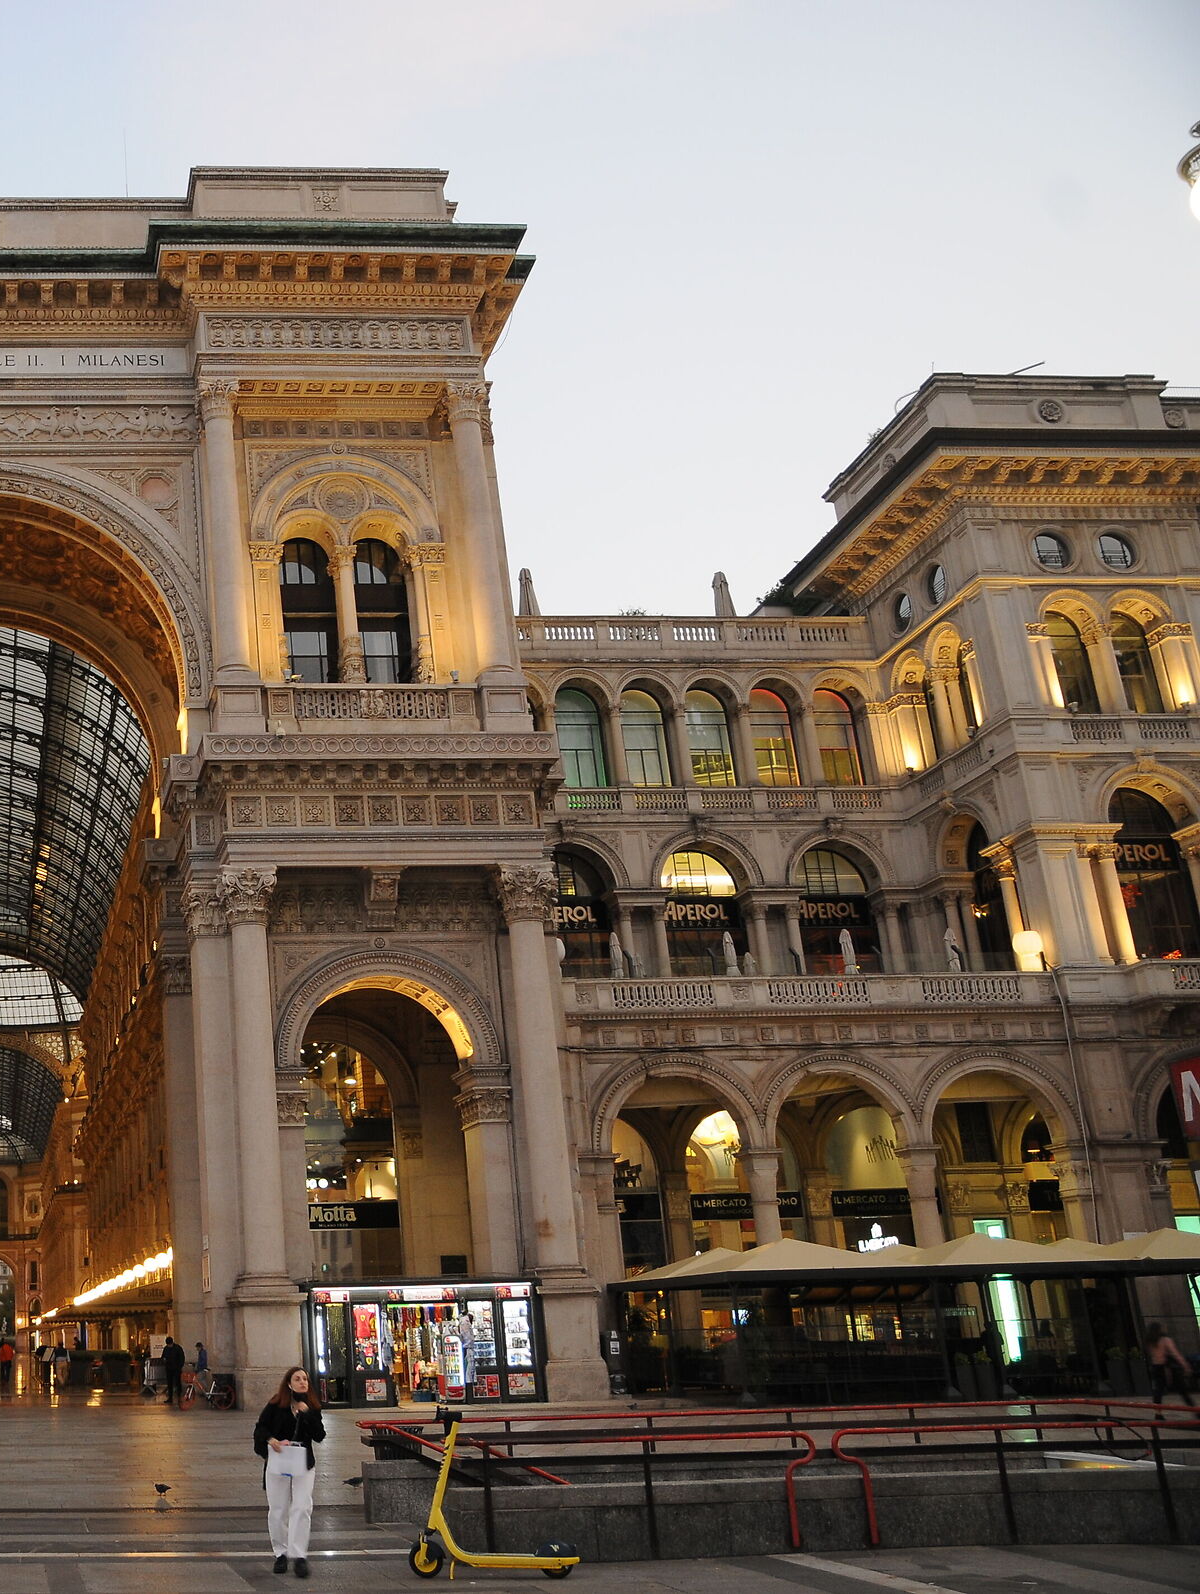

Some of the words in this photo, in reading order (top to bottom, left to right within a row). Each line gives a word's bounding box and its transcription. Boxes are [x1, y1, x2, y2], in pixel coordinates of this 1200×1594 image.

[60, 354, 66, 367] I
[77, 354, 165, 367] MILANESI
[1114, 844, 1171, 862] PEROL
[553, 905, 598, 923] EROL
[664, 901, 729, 920] APEROL
[800, 900, 861, 919] APEROL
[555, 922, 599, 930] RAZZA
[703, 1198, 747, 1208] MERCATO
[776, 1196, 798, 1206] OMO
[843, 1194, 886, 1205] MERCATO
[309, 1205, 357, 1222] Motta
